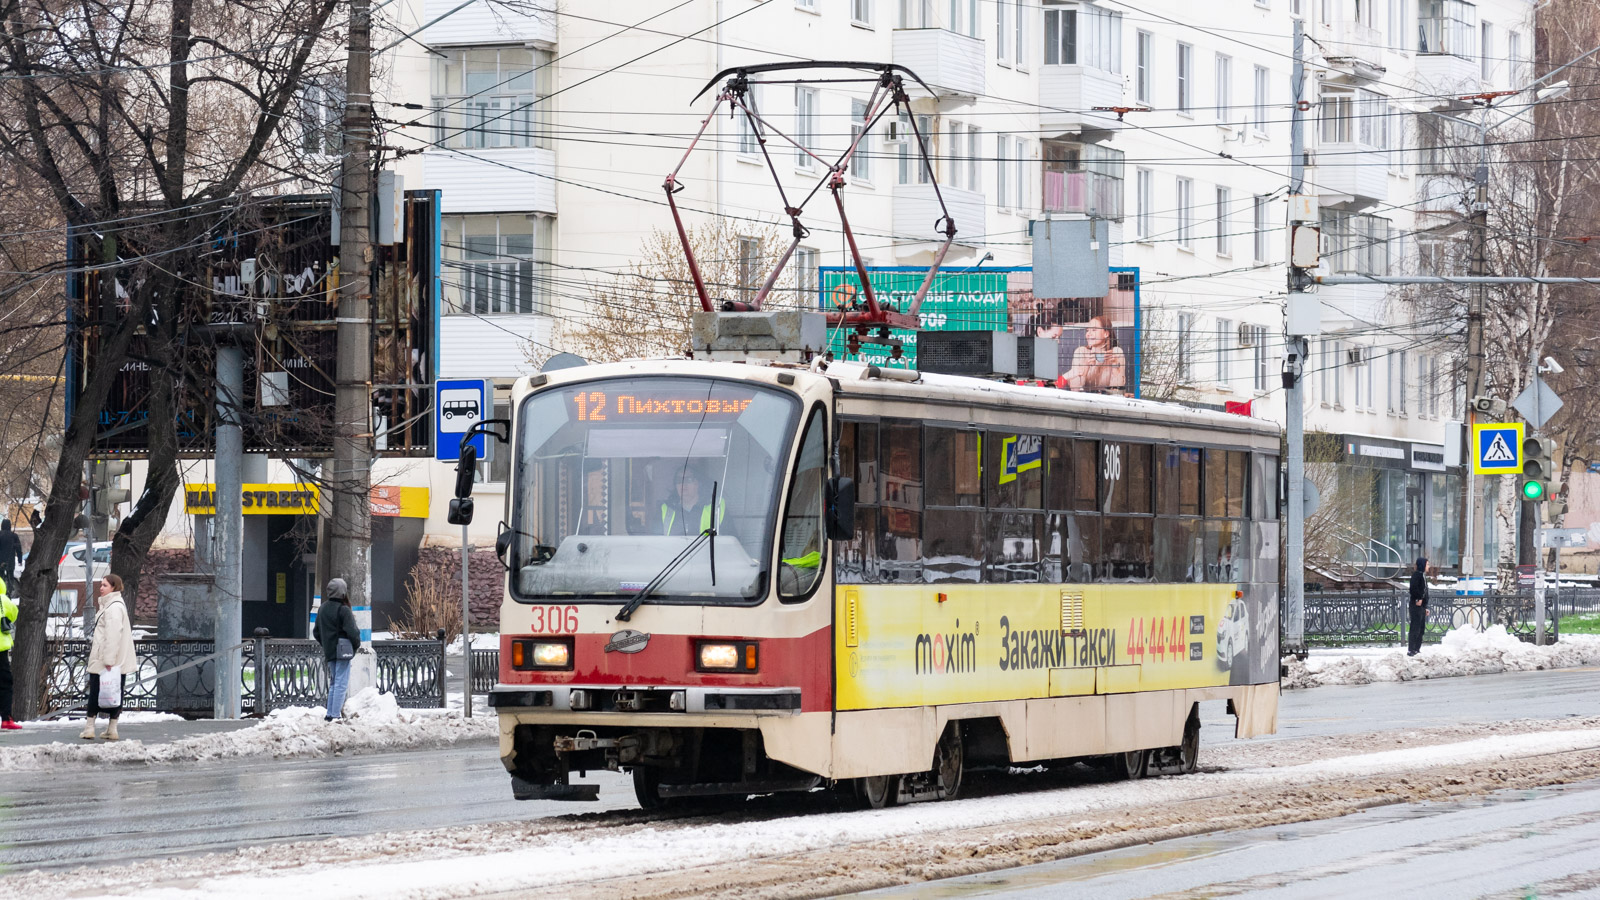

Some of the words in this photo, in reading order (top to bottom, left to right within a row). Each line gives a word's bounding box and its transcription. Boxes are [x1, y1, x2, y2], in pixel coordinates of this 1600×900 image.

[958, 290, 1004, 304] ЛЮДИ
[574, 391, 606, 421] 12
[1104, 444, 1121, 481] 306
[242, 490, 315, 507] STREET
[531, 605, 579, 633] 306
[915, 617, 976, 675] maxim
[999, 615, 1067, 671] Закажи
[1070, 627, 1116, 667] такси
